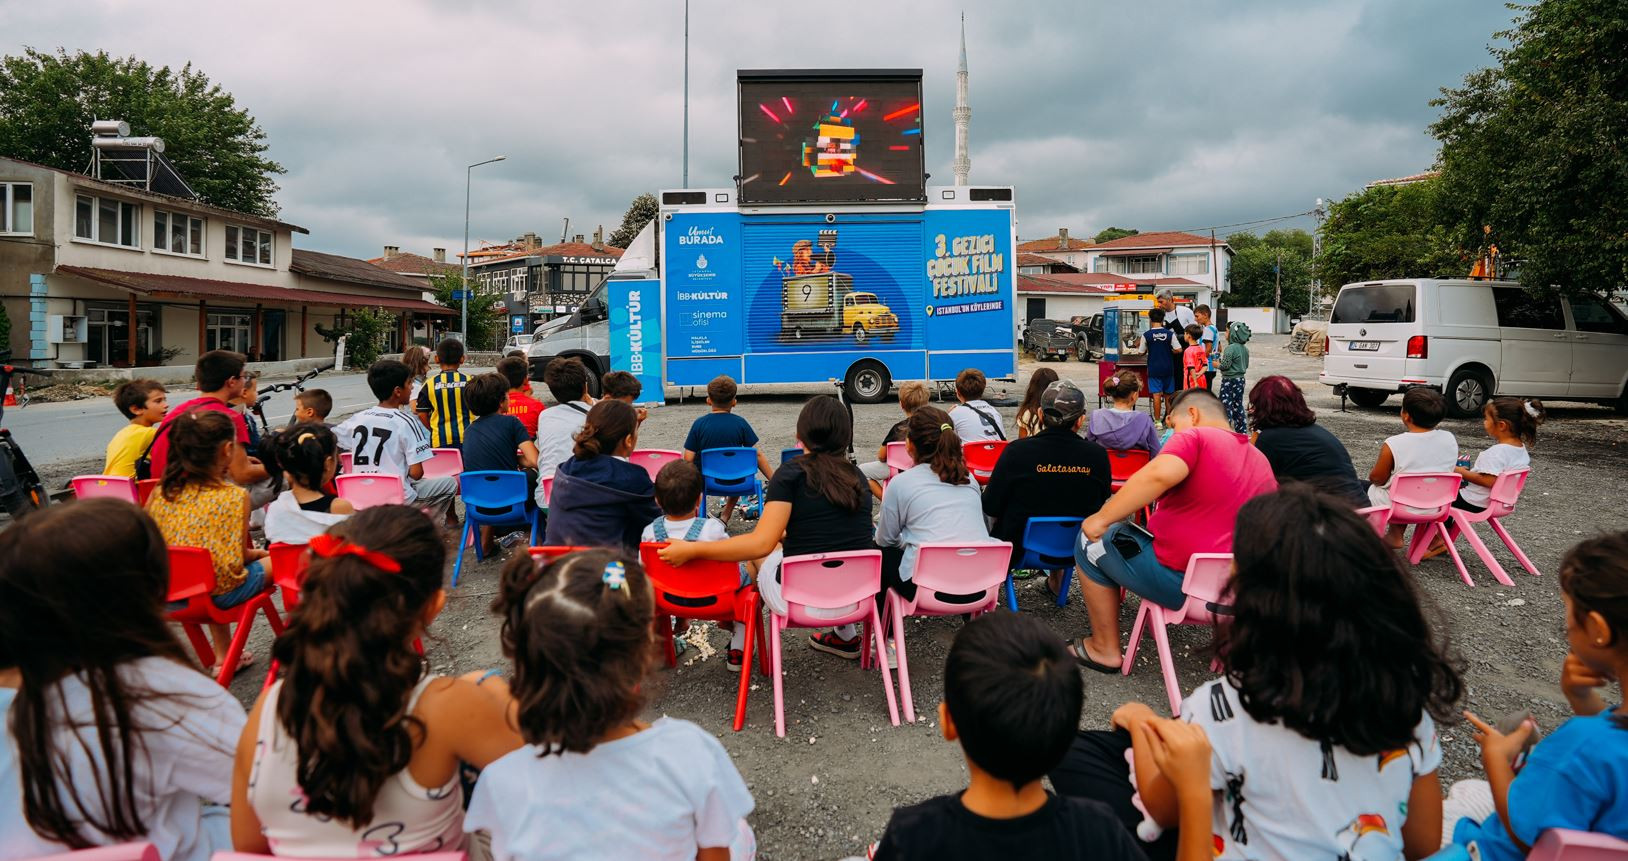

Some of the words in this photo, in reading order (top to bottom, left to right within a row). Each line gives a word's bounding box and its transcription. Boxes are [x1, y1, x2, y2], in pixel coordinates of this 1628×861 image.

[679, 235, 724, 244] BURADA
[935, 234, 951, 257] 3.
[580, 257, 617, 265] ÇATALCA
[927, 255, 970, 280] ÇOCUK
[972, 252, 1003, 275] FİLM
[802, 284, 812, 302] 9
[692, 310, 727, 319] sinema
[692, 318, 709, 327] ofisi
[352, 425, 392, 466] 27
[1036, 463, 1091, 476] Galatasaray
